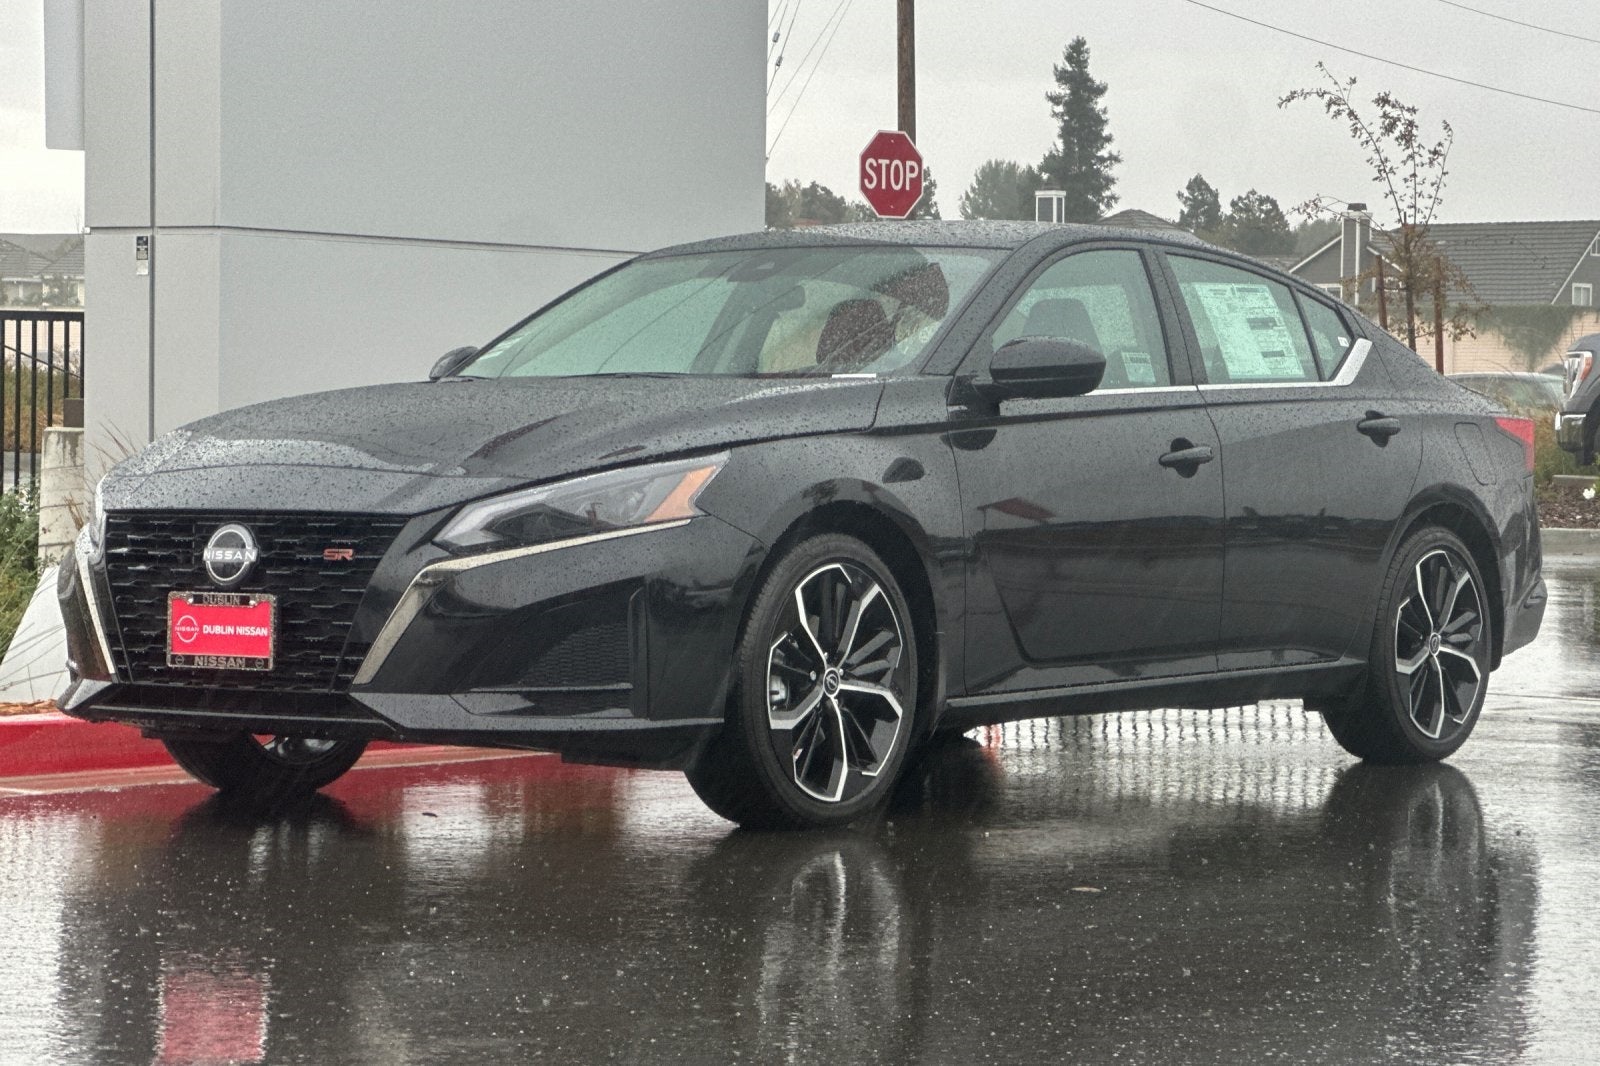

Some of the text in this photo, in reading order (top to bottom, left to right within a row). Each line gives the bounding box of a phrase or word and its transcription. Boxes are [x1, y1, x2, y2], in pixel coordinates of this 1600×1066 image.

[864, 157, 919, 191] STOP
[203, 549, 257, 561] NISSAN
[323, 548, 354, 561] SR
[202, 594, 240, 605] DUBLIN
[202, 624, 268, 636] DUBLIN NISSAN
[193, 655, 246, 669] NISSAN
